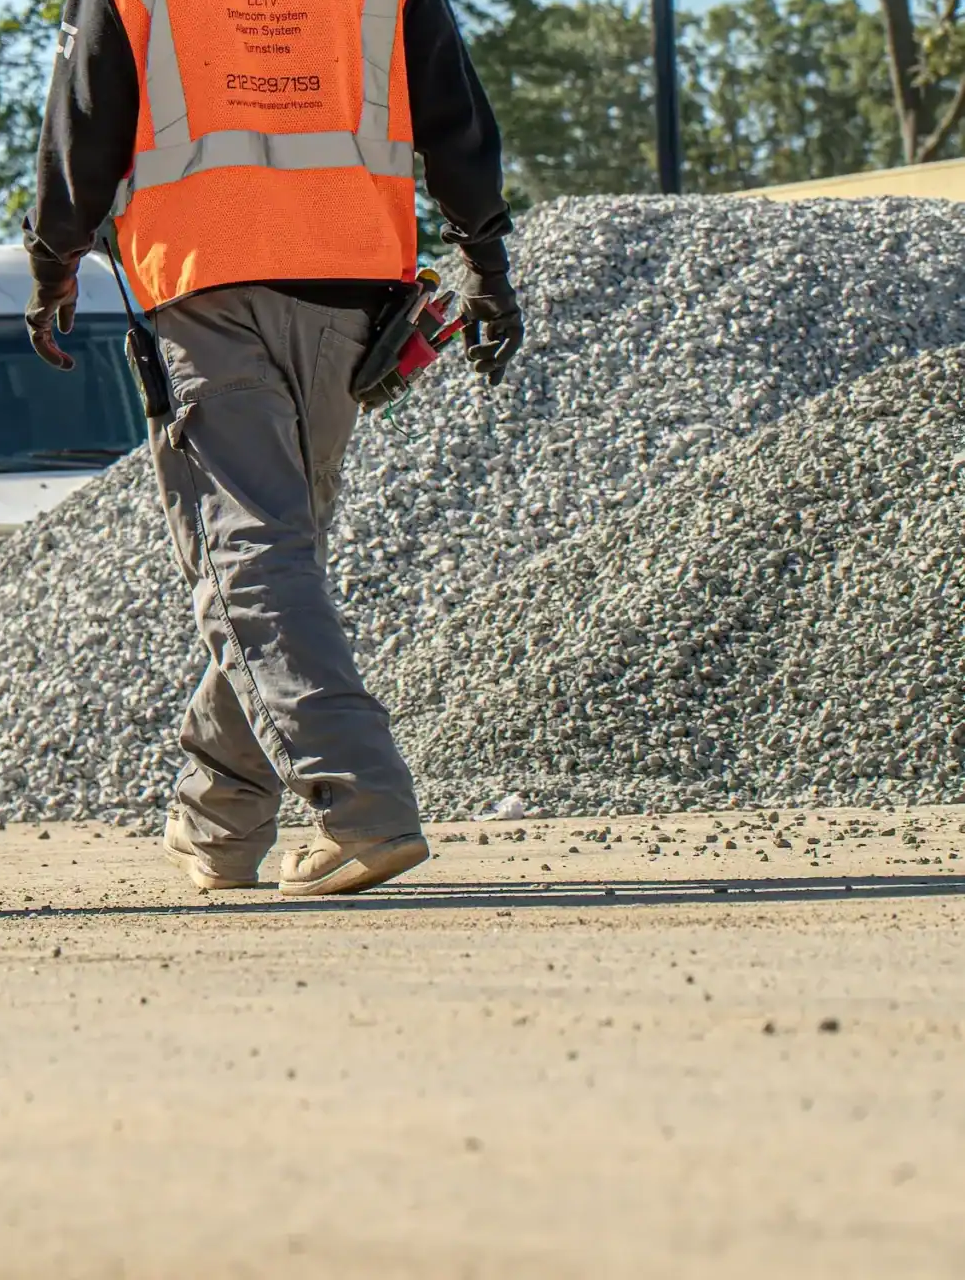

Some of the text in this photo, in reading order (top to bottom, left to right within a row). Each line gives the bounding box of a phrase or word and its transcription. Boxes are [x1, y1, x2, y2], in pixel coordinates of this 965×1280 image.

[269, 11, 308, 24] system
[261, 25, 301, 37] System
[226, 74, 320, 93] 212529.7159
